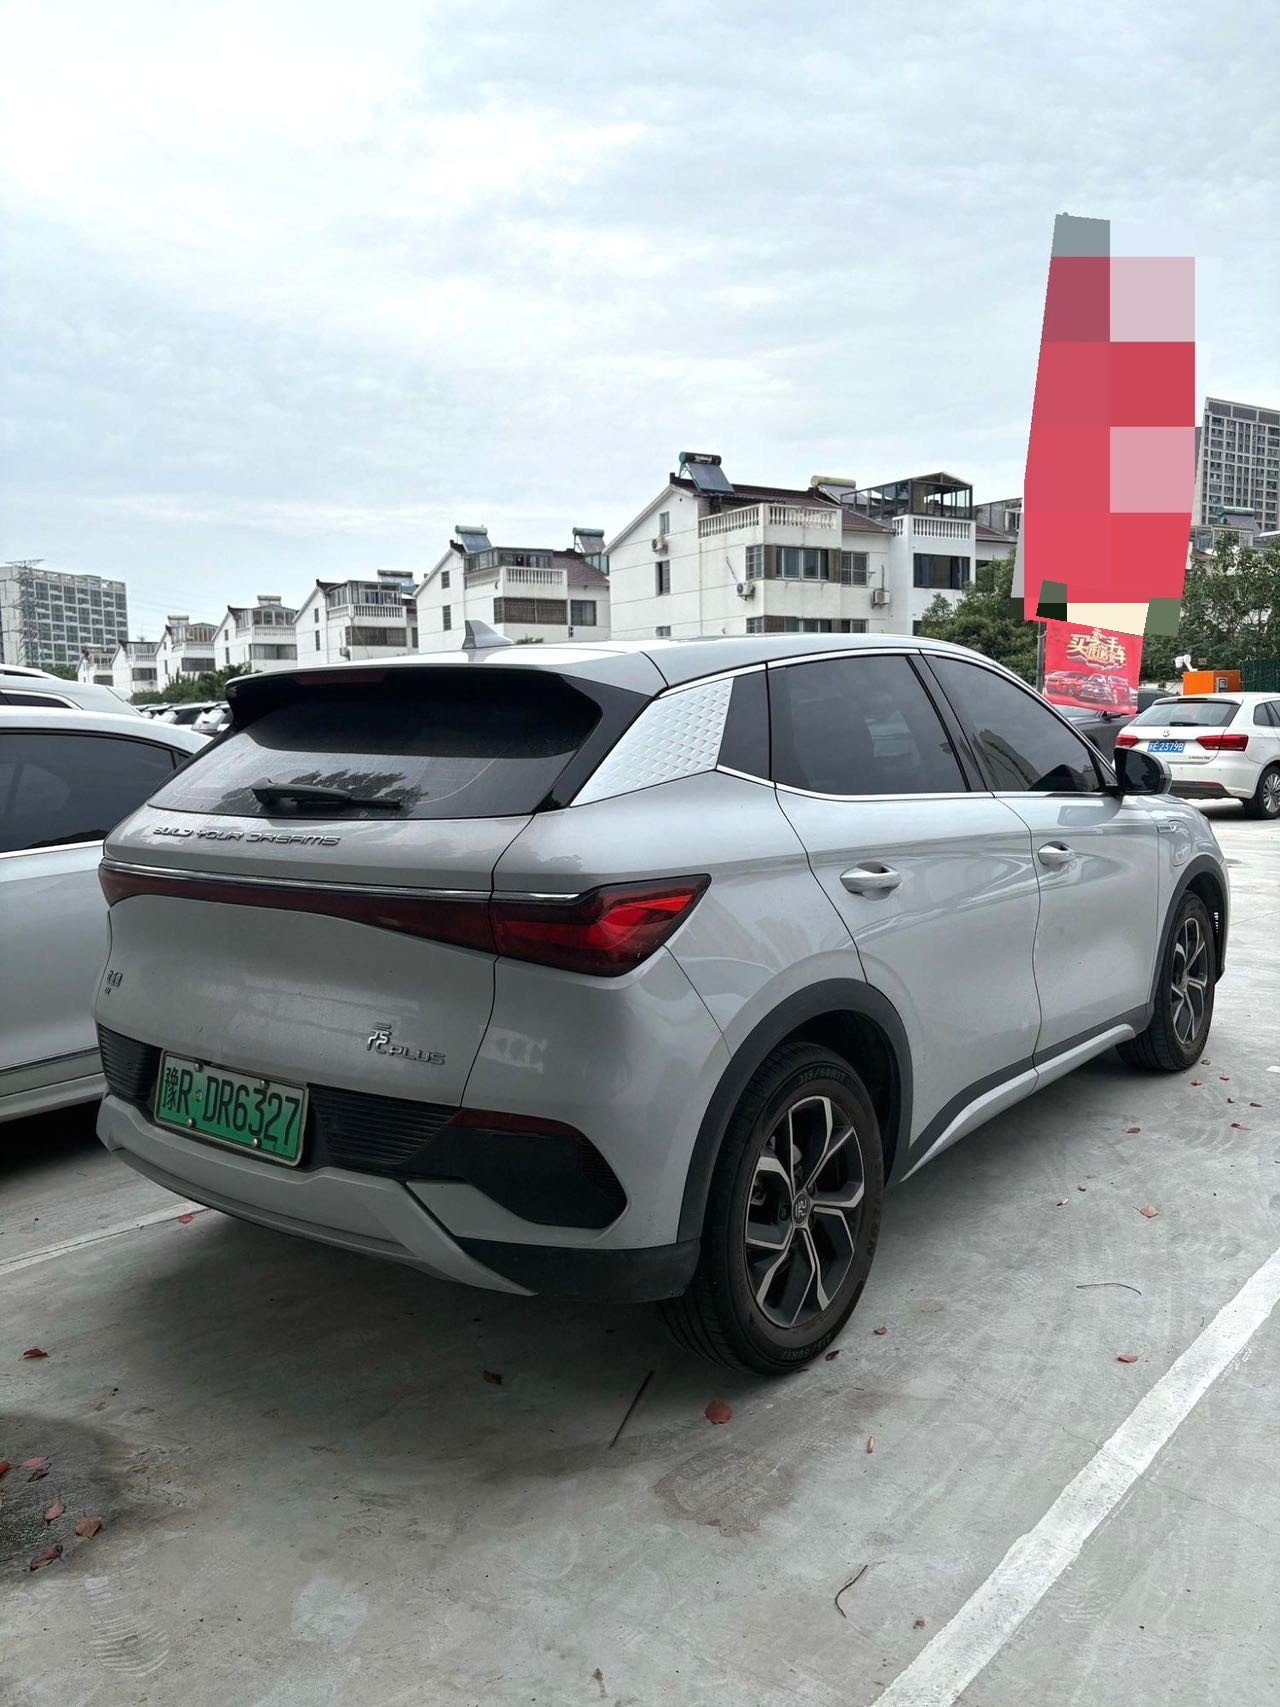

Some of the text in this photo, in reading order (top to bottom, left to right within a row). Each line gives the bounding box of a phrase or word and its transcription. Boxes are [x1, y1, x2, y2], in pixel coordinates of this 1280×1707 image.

[196, 830, 244, 841] YOUR
[246, 833, 342, 846] DREAMS
[389, 1045, 447, 1066] PLUS
